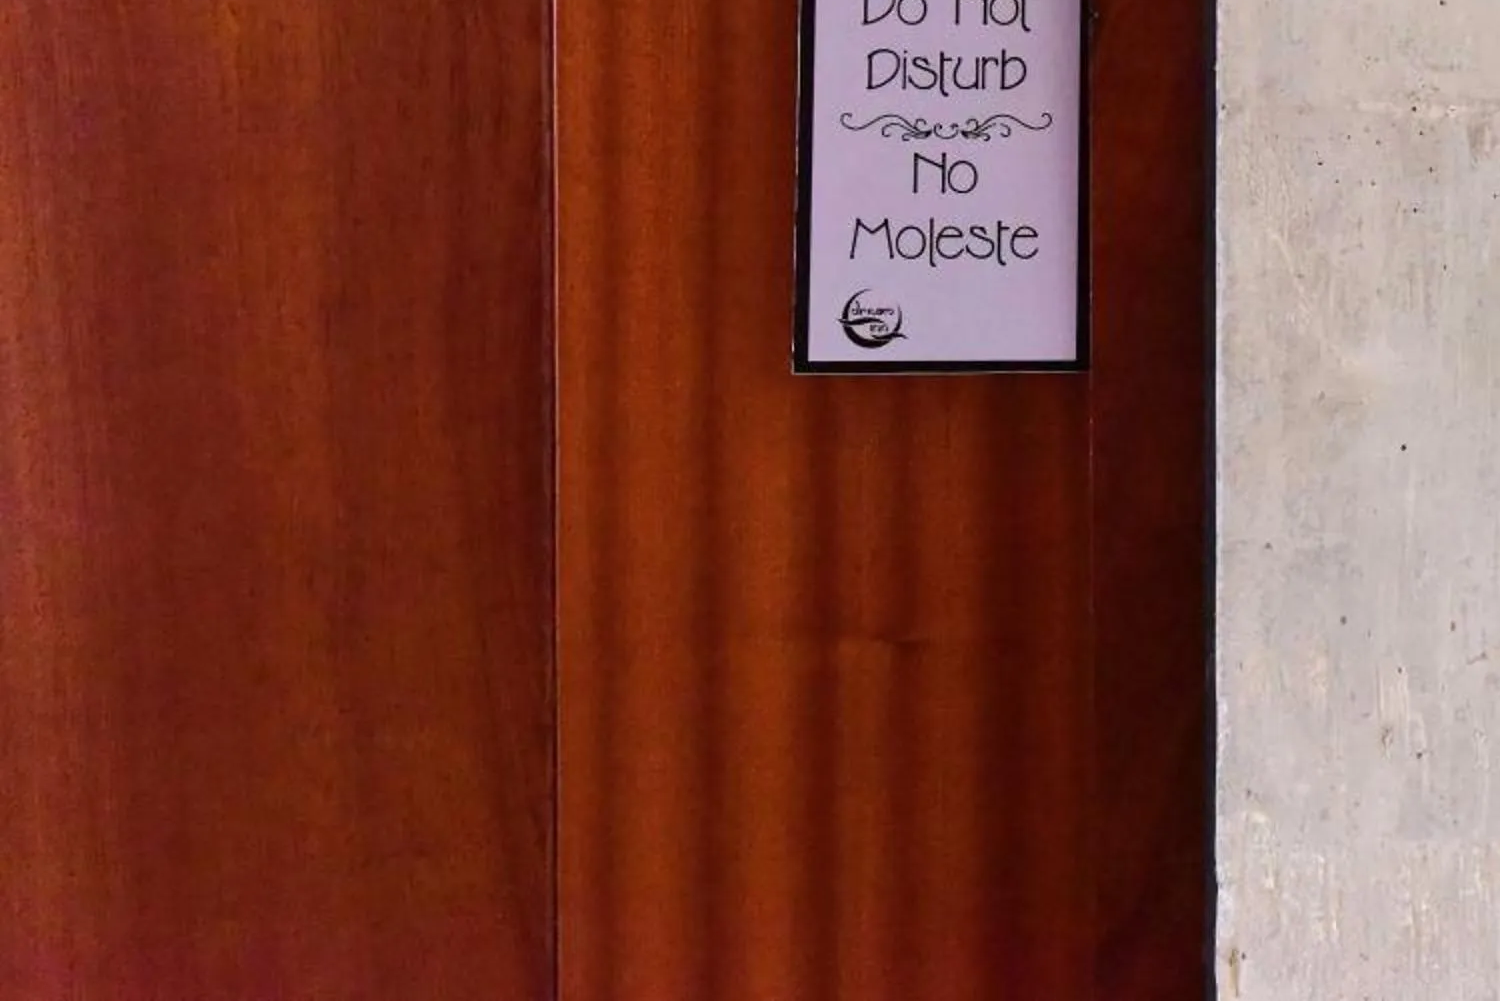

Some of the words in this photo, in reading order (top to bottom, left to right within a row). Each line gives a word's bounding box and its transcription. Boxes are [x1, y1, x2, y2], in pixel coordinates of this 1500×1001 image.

[865, 47, 1028, 98] Disturb
[911, 151, 979, 195] No
[848, 216, 1040, 268] Moleste
